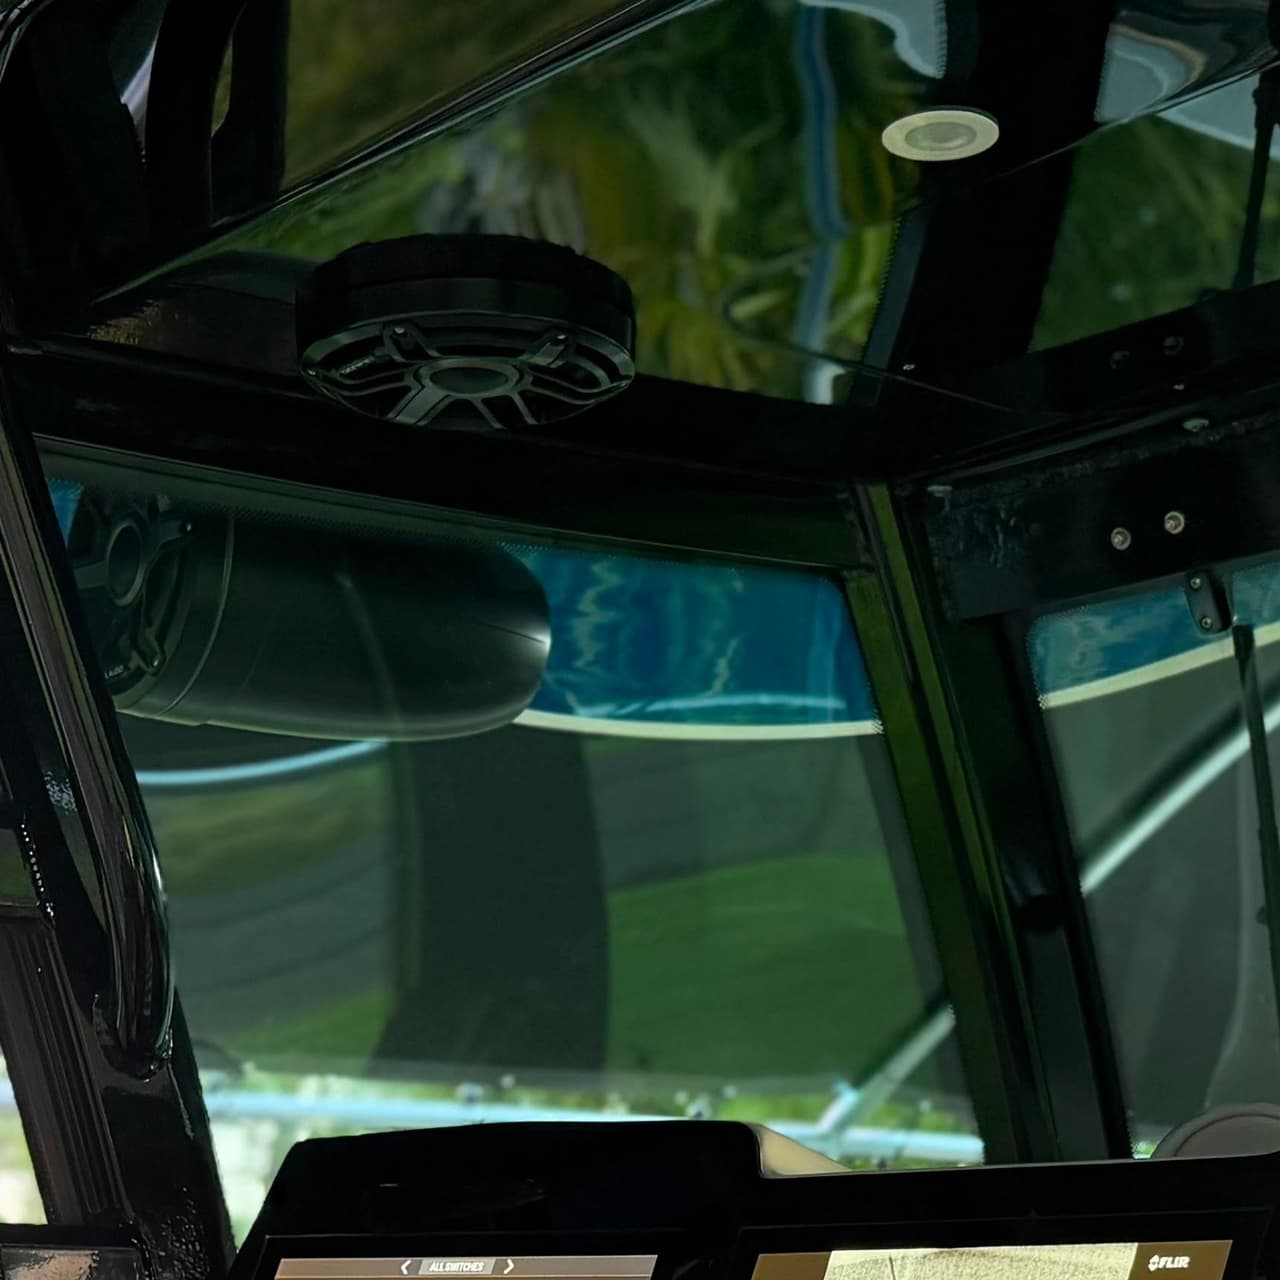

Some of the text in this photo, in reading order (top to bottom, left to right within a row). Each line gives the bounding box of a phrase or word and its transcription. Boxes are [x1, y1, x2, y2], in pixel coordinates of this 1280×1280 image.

[429, 1261, 485, 1272] ALL SWITCHES
[1158, 1256, 1191, 1269] FLIR
